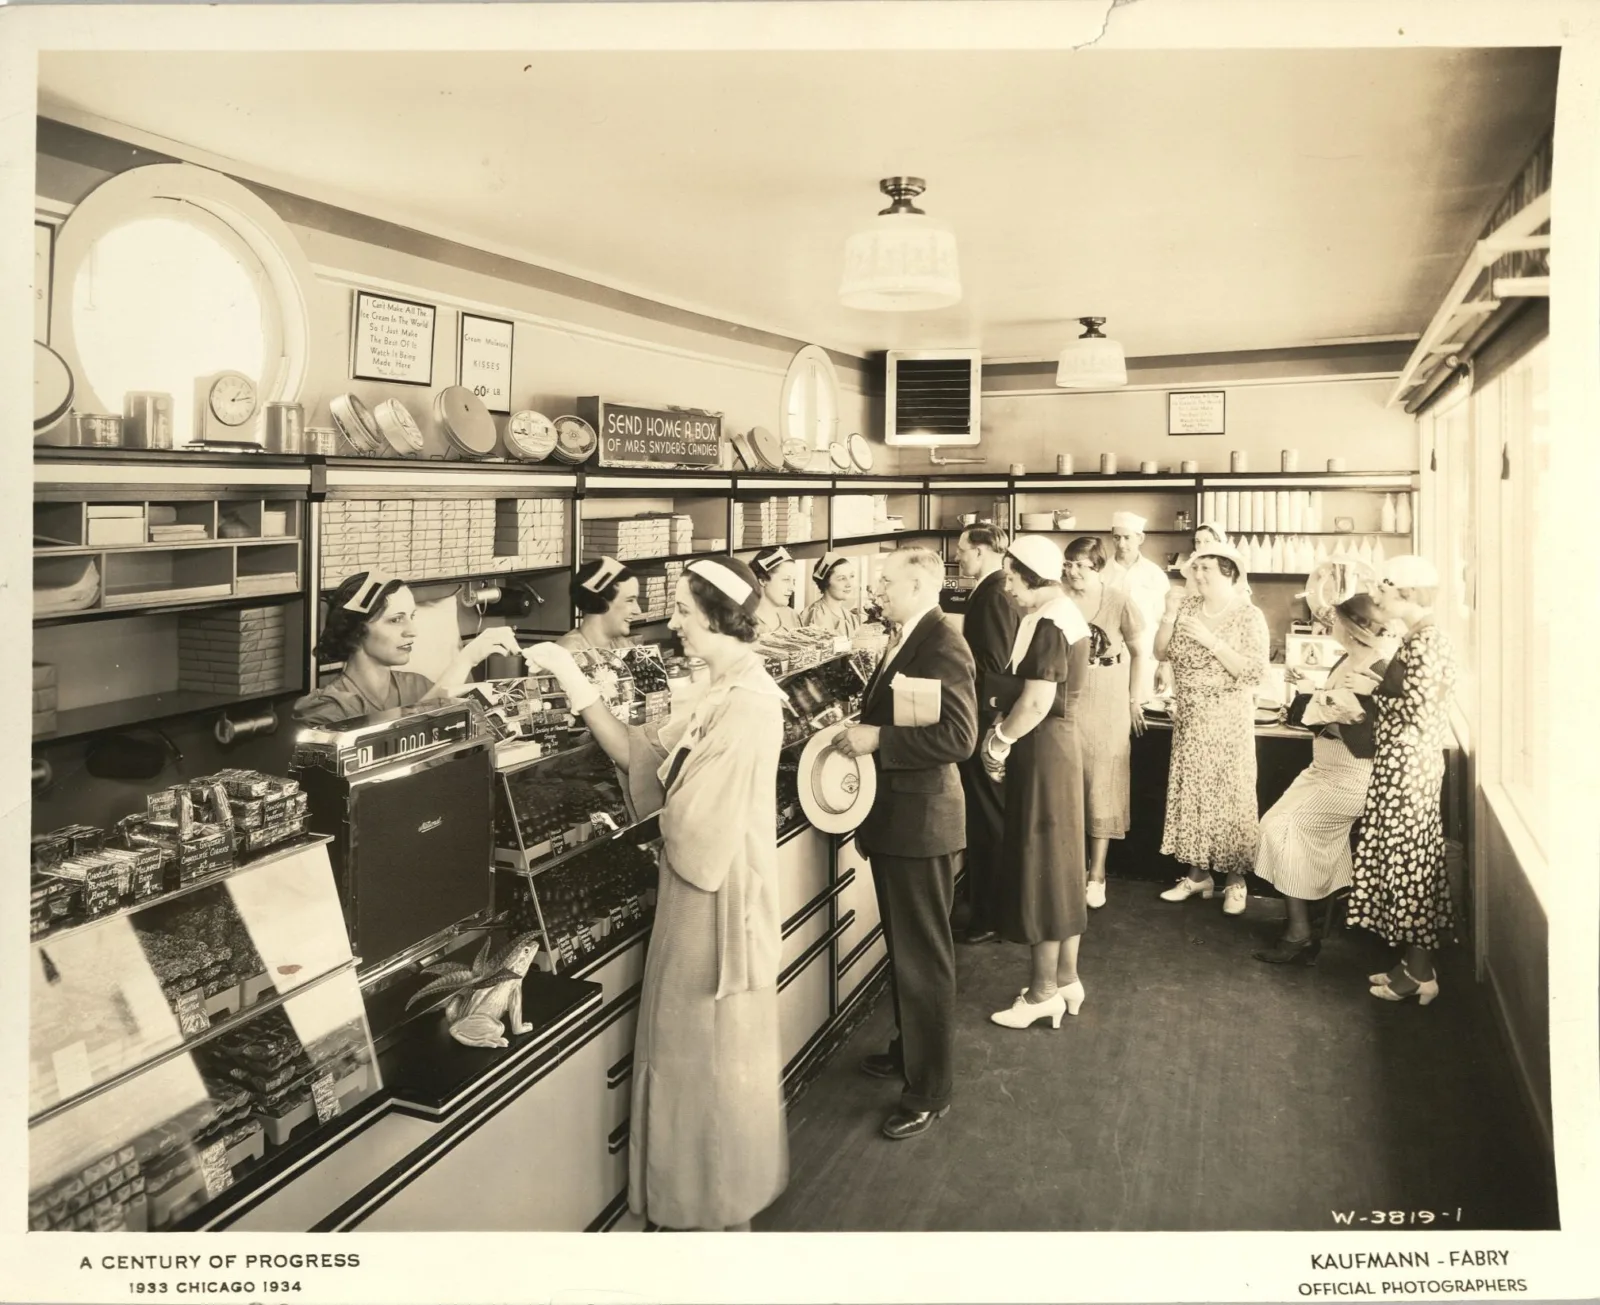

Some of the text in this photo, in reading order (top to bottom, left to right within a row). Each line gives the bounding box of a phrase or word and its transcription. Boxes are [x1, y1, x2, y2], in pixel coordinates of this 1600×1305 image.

[387, 303, 403, 312] Make
[417, 308, 427, 317] The
[372, 312, 389, 321] Cream
[399, 316, 408, 325] The
[410, 318, 429, 328] World
[369, 323, 377, 331] So
[387, 326, 398, 334] Just
[401, 329, 418, 338] Make
[370, 335, 381, 344] The
[384, 337, 398, 346] Best
[400, 339, 410, 348] Of
[464, 333, 481, 343] Cream
[370, 347, 390, 357] Watch
[399, 351, 416, 361] Being
[372, 358, 391, 367] Made
[474, 360, 500, 370] KISSES
[608, 414, 717, 441] SEND HOME A BOX
[608, 438, 621, 451] OF
[649, 440, 686, 455] SNYDER'S
[688, 443, 718, 456] CANDIES
[946, 580, 956, 588] 20
